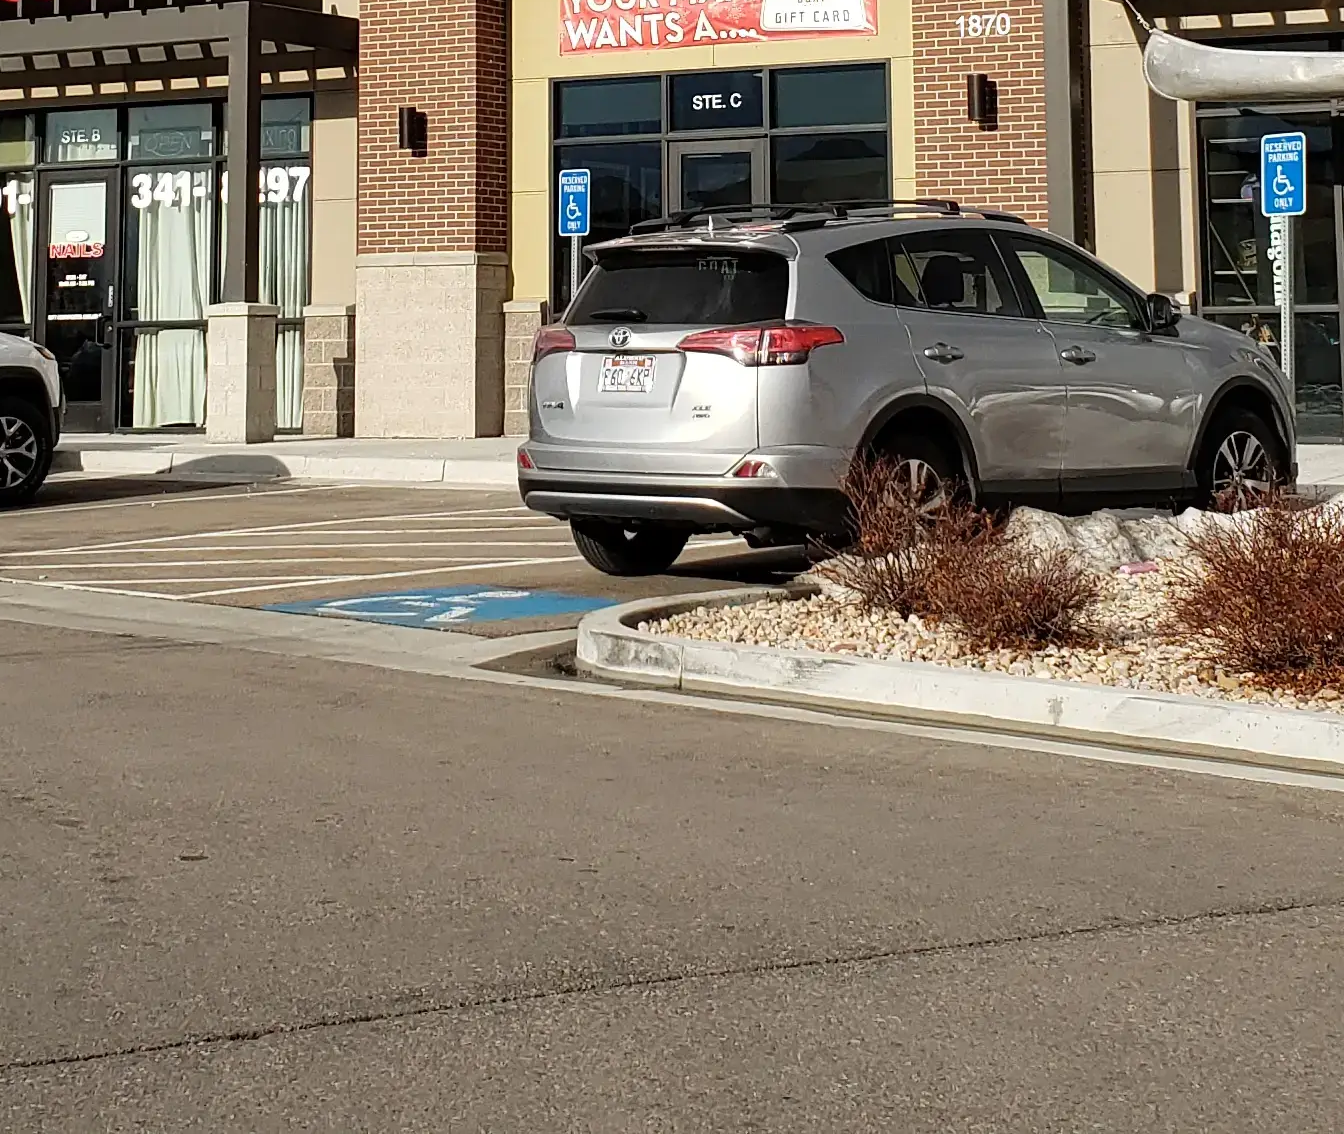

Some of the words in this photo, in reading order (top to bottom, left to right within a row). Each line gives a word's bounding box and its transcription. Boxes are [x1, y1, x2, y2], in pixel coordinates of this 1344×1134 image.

[774, 12, 805, 24] GIFT
[812, 9, 851, 23] CARD
[563, 12, 684, 50] WANTS
[955, 12, 1011, 39] 1870
[692, 94, 727, 110] STE.
[729, 92, 743, 108] C
[61, 129, 89, 144] STE.
[91, 128, 101, 142] B
[1264, 141, 1302, 152] RESERVED
[1268, 152, 1299, 162] PARKING
[562, 175, 587, 184] RESERVED
[131, 171, 206, 208] 341-
[564, 185, 586, 193] PARKING
[1274, 197, 1293, 208] ONLY
[567, 221, 581, 229] ONLY
[49, 242, 104, 259] NAILS
